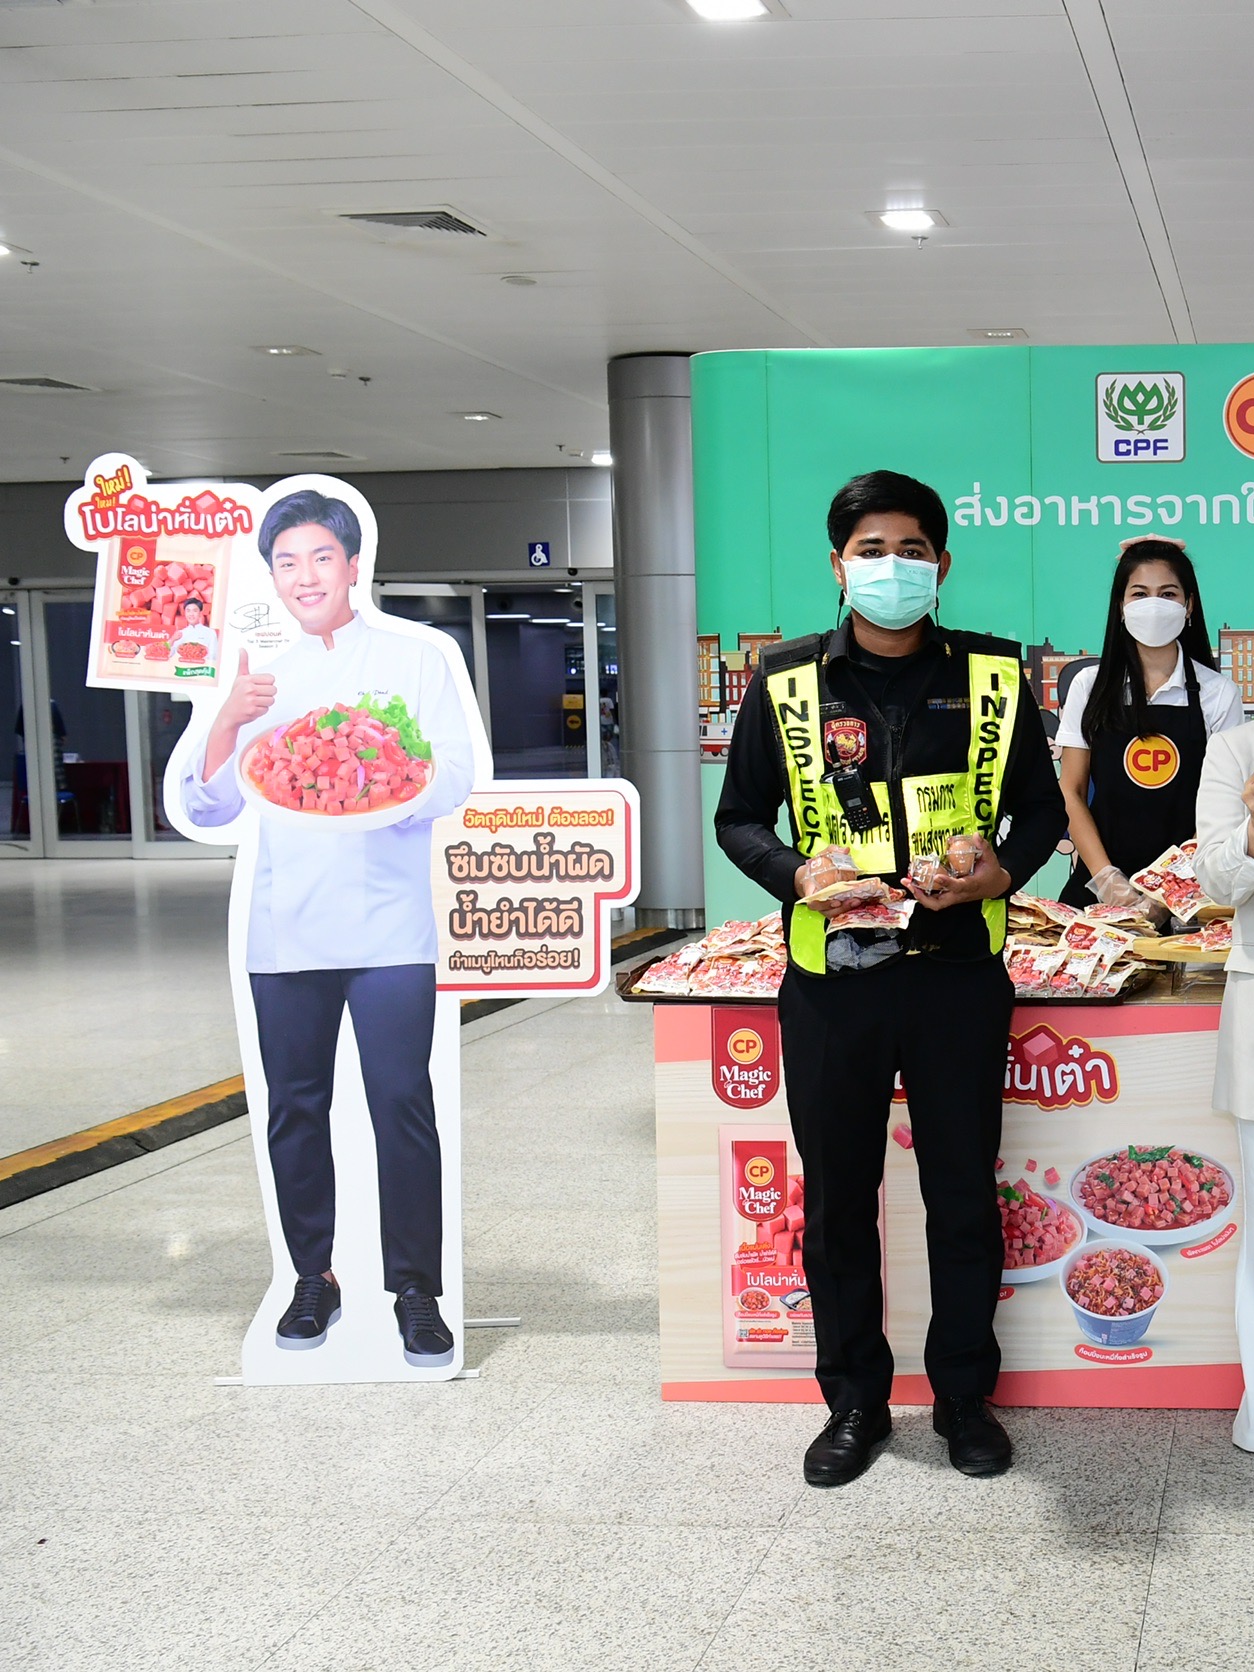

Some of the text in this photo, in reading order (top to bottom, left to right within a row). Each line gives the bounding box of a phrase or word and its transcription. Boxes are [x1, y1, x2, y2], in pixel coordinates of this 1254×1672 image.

[1114, 439, 1169, 456] CPF
[96, 466, 131, 495] ใหม่!
[81, 501, 249, 536] โบโลน่าหั่นเต๋า
[129, 552, 144, 560] CP
[121, 565, 150, 577] Magic
[123, 575, 146, 585] Chef
[1132, 749, 1171, 772] CP
[917, 784, 956, 812] กรมการ
[465, 808, 613, 832] วัตถุดิบใหม่ ต้องลอง!
[449, 836, 610, 878] ซึมซับน้ำผัด
[452, 894, 580, 935] น้ำยำได้ดี
[450, 946, 580, 974] ทำเมนูไหนก็อร่อย!
[733, 1039, 757, 1053] CP
[720, 1065, 772, 1085] Magic
[726, 1083, 766, 1099] Chef
[749, 1166, 769, 1177] CP
[739, 1187, 782, 1203] Magic
[744, 1201, 777, 1214] Chef
[746, 1269, 807, 1286] โบโลน่าหั่น
